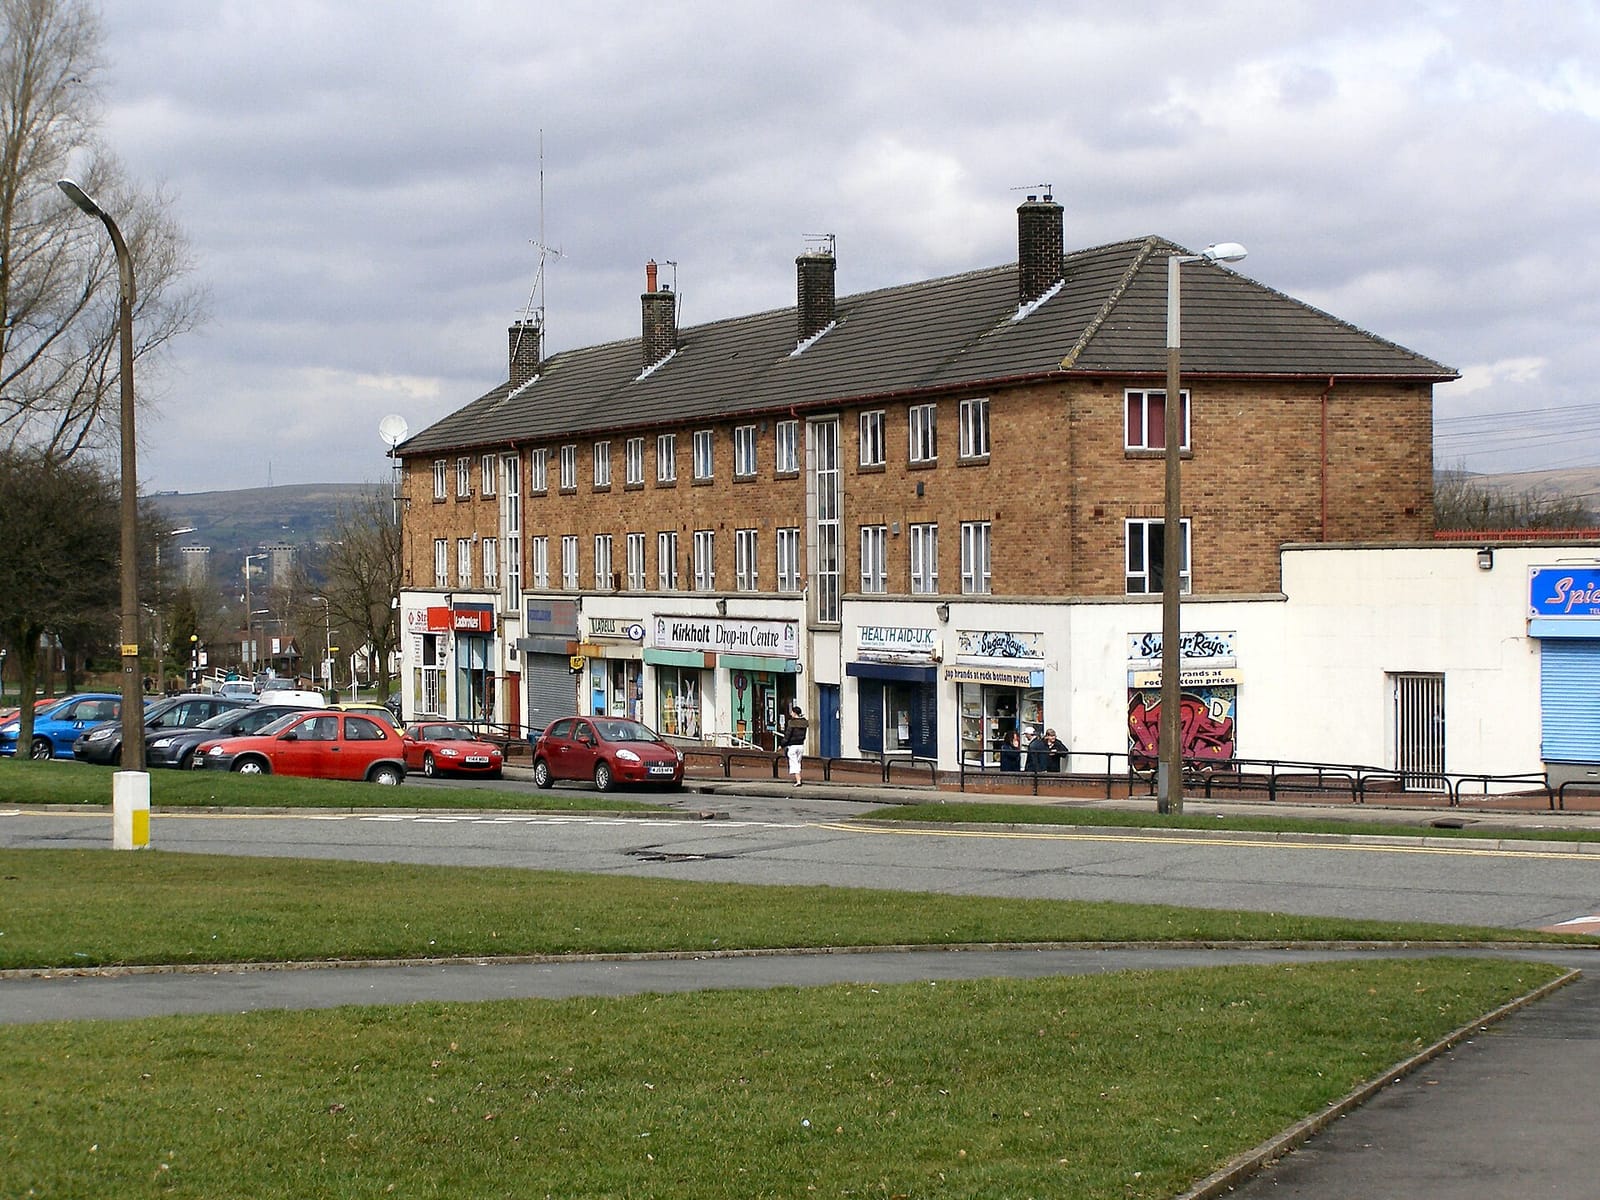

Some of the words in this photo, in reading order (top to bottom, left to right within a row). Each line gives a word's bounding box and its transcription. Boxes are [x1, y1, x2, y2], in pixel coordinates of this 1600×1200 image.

[672, 624, 710, 642] Kirkholt
[716, 625, 748, 649] Drop-in
[751, 626, 779, 647] Centre
[861, 627, 896, 641] HEALTH
[1190, 632, 1224, 657] Rays
[954, 669, 973, 679] brands
[980, 671, 992, 680] rock
[993, 672, 1013, 682] bottom
[1013, 674, 1030, 684] prices
[1206, 677, 1235, 685] prices
